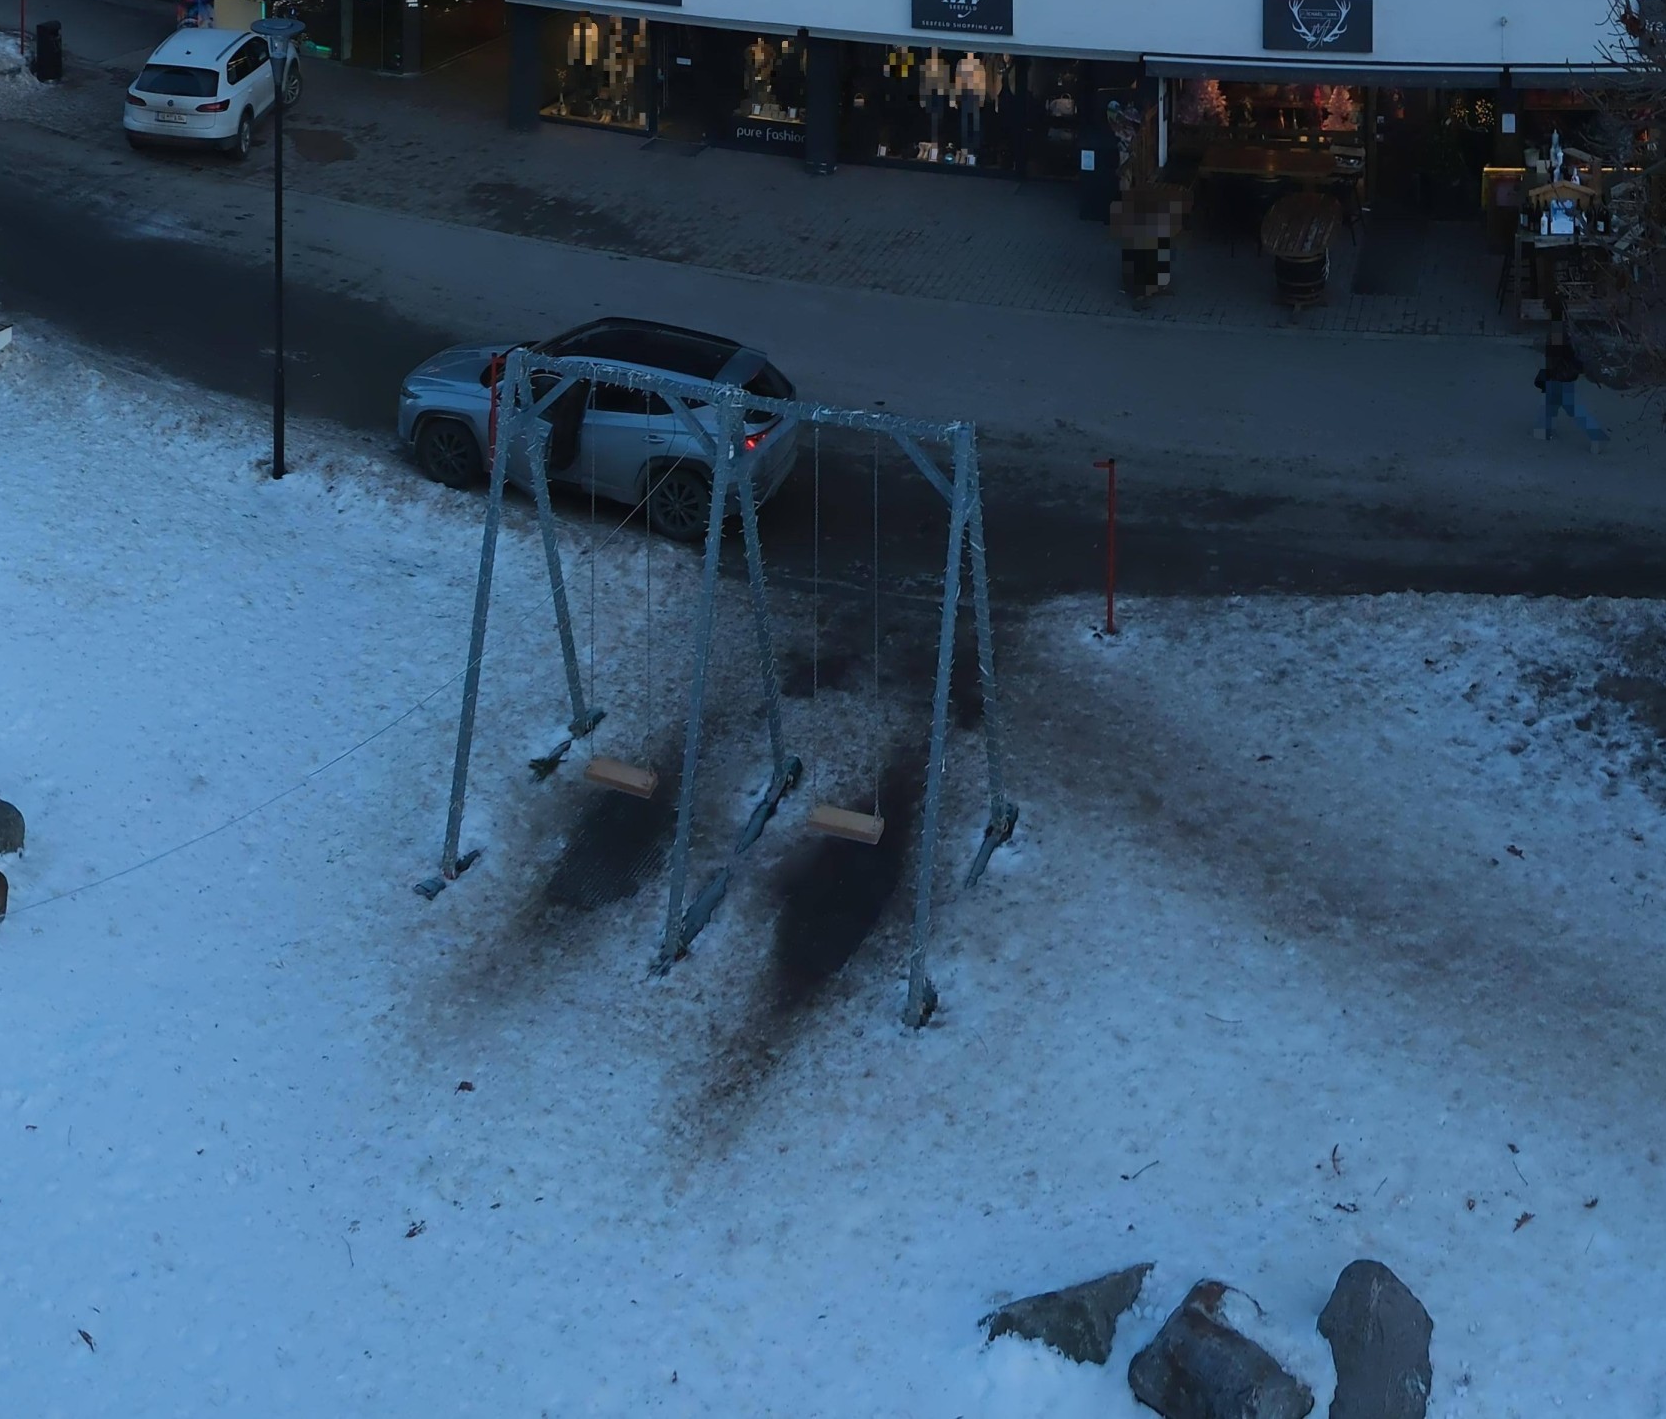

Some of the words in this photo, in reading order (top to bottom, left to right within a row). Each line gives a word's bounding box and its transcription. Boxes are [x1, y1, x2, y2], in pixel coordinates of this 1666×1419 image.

[921, 19, 951, 27] SEEFELD
[952, 22, 988, 30] SHOPPING
[736, 126, 762, 138] pure
